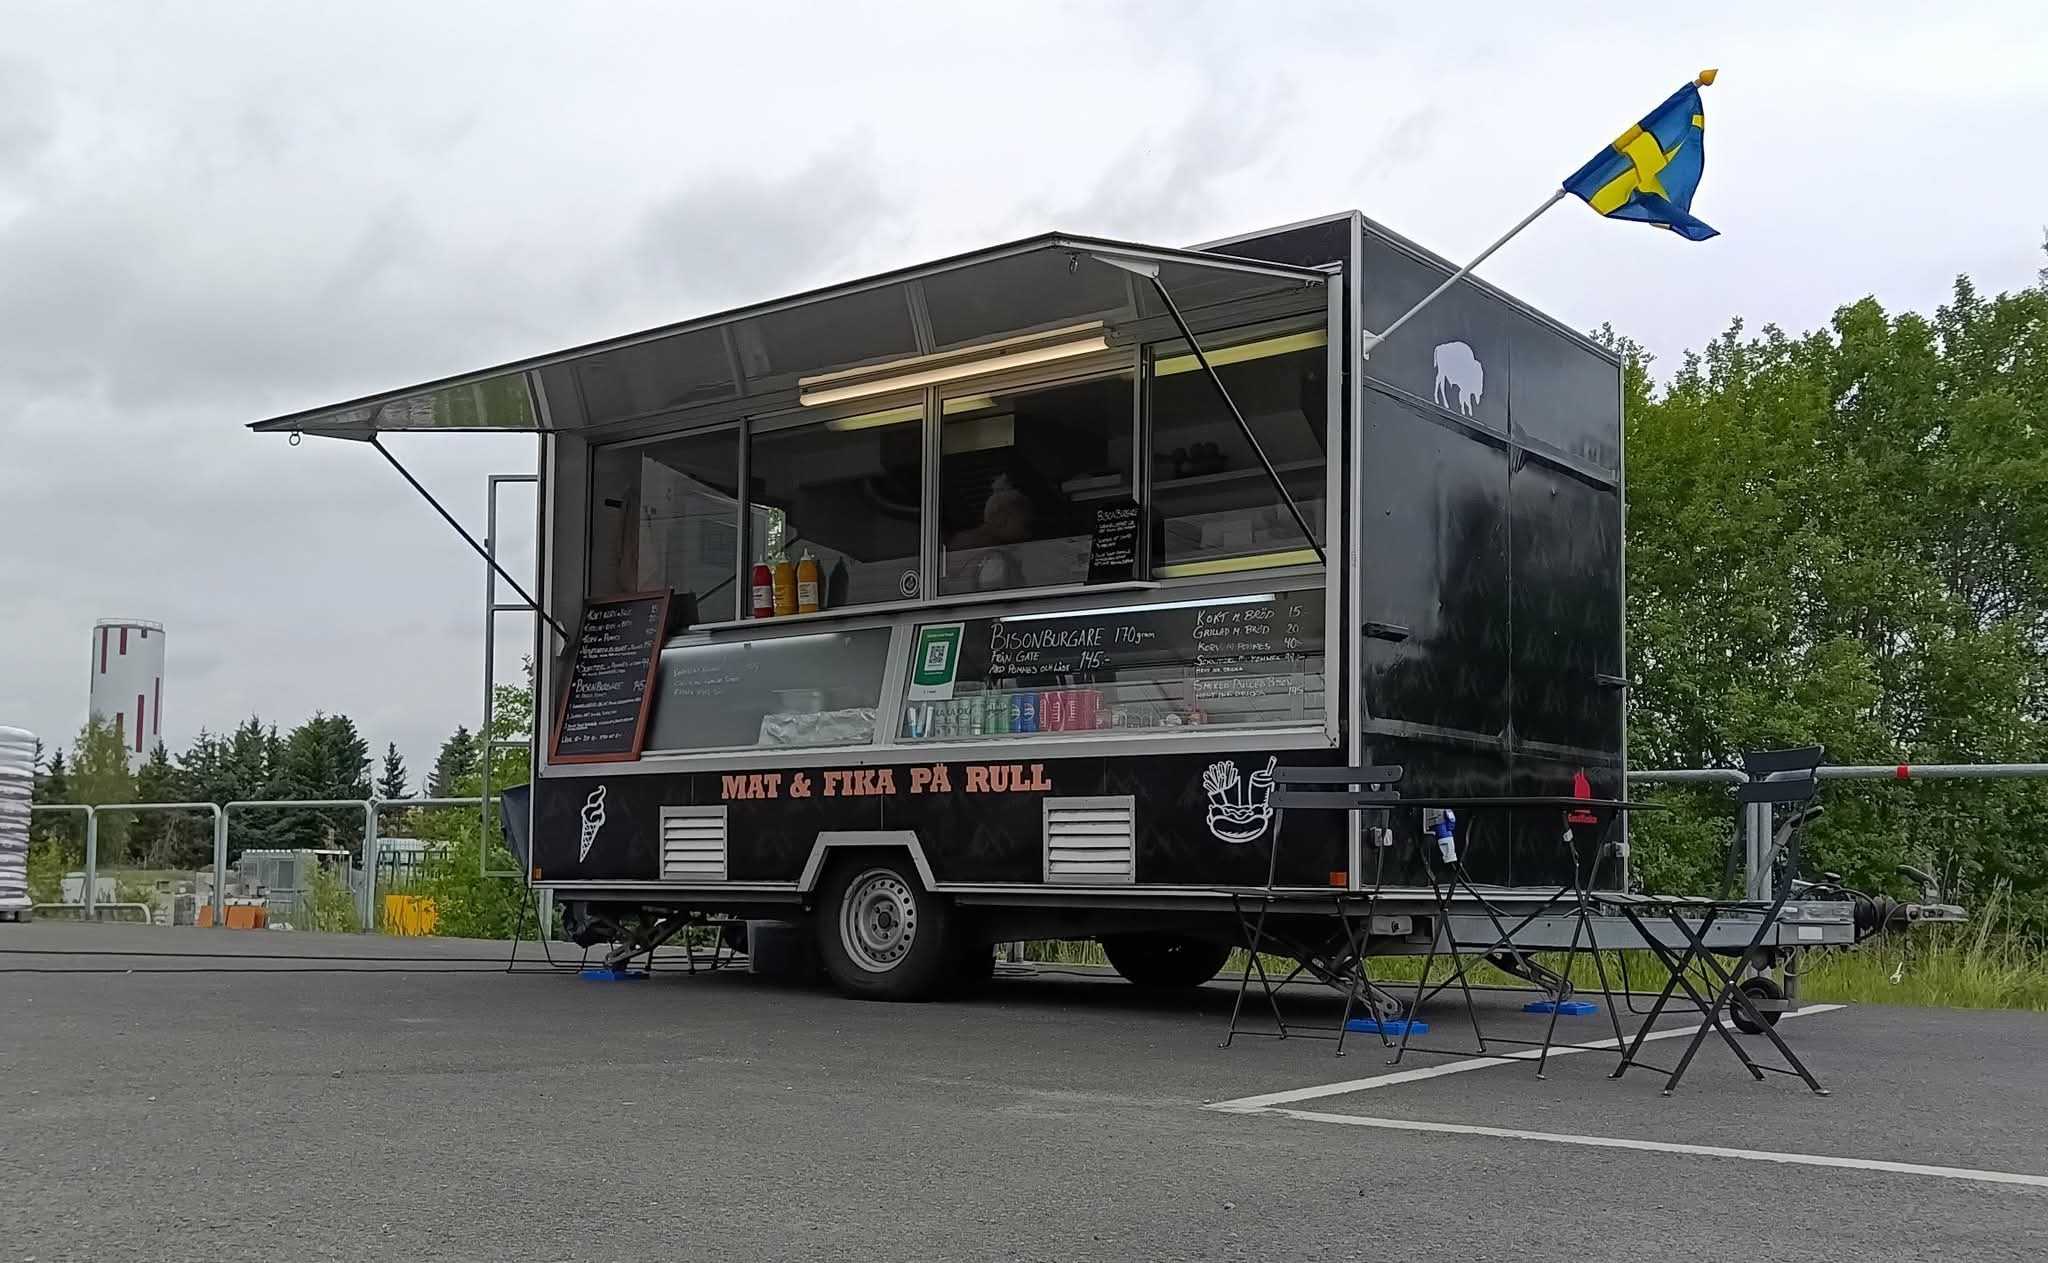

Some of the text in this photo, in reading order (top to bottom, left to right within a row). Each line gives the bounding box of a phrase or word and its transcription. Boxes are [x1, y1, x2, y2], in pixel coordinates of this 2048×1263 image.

[1197, 610, 1230, 626] KOKT
[1243, 607, 1275, 621] BRÖD
[990, 623, 1105, 650] BISONBURGARE
[1193, 626, 1230, 639] GRILLAD
[1245, 624, 1271, 635] BRÖD
[721, 774, 781, 799] MAT
[789, 772, 811, 798] &
[823, 769, 896, 797] FIKA
[965, 763, 1051, 793] RULL
